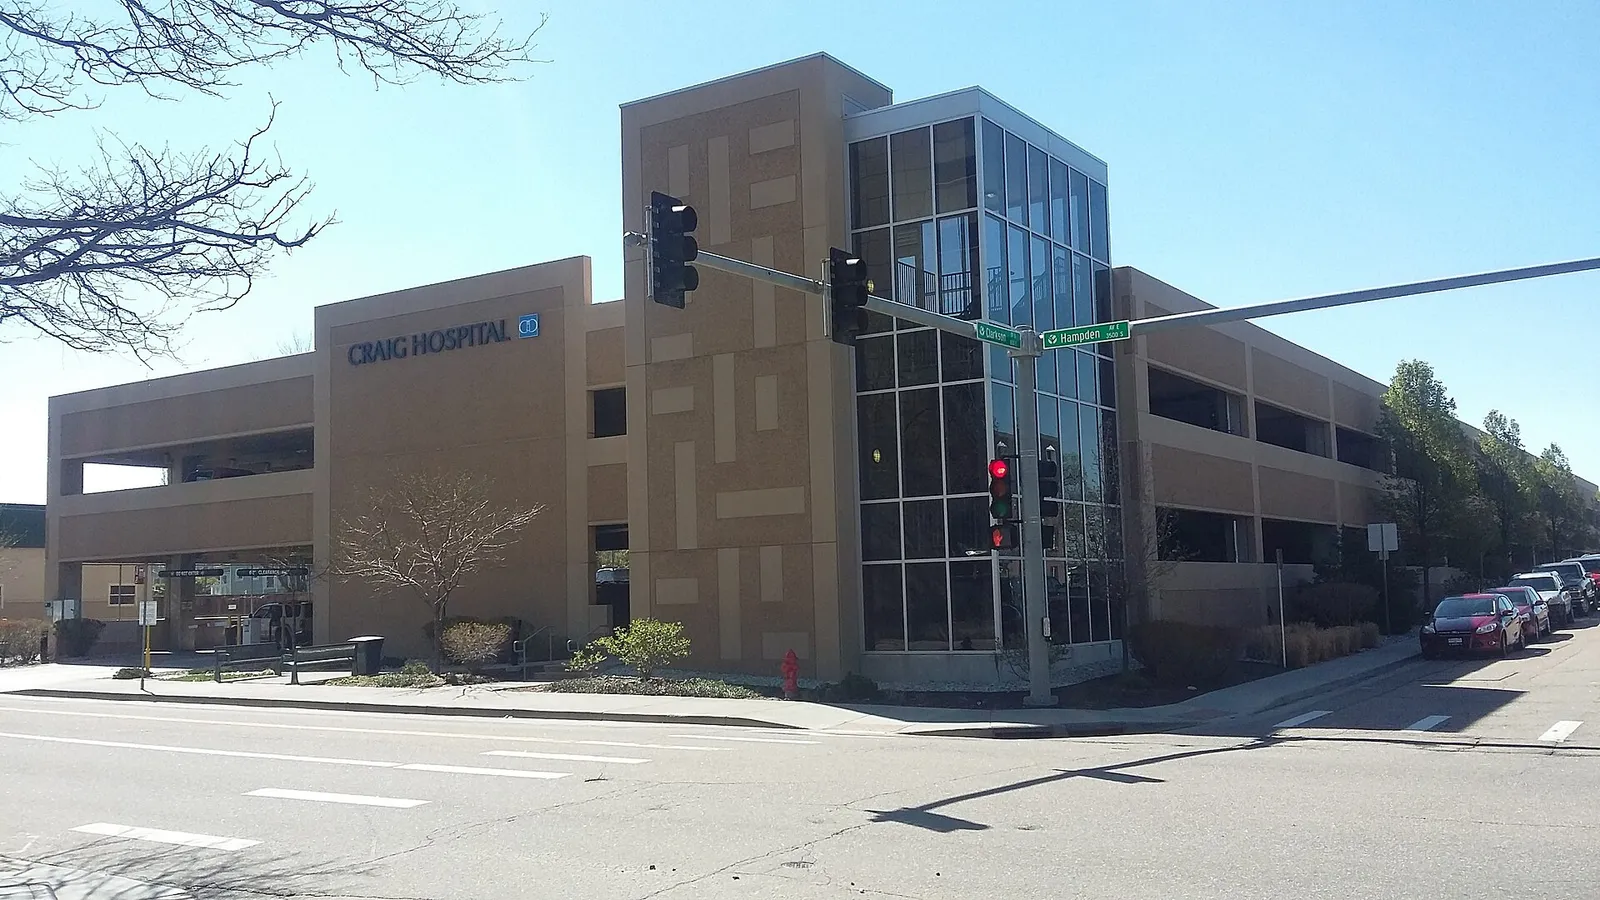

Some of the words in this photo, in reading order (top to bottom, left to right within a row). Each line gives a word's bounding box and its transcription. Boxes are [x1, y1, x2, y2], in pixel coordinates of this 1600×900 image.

[985, 327, 1007, 342] Clarkson
[1060, 330, 1101, 344] Hampden
[347, 336, 407, 366] CRAIG
[411, 319, 511, 356] HOSPITAL
